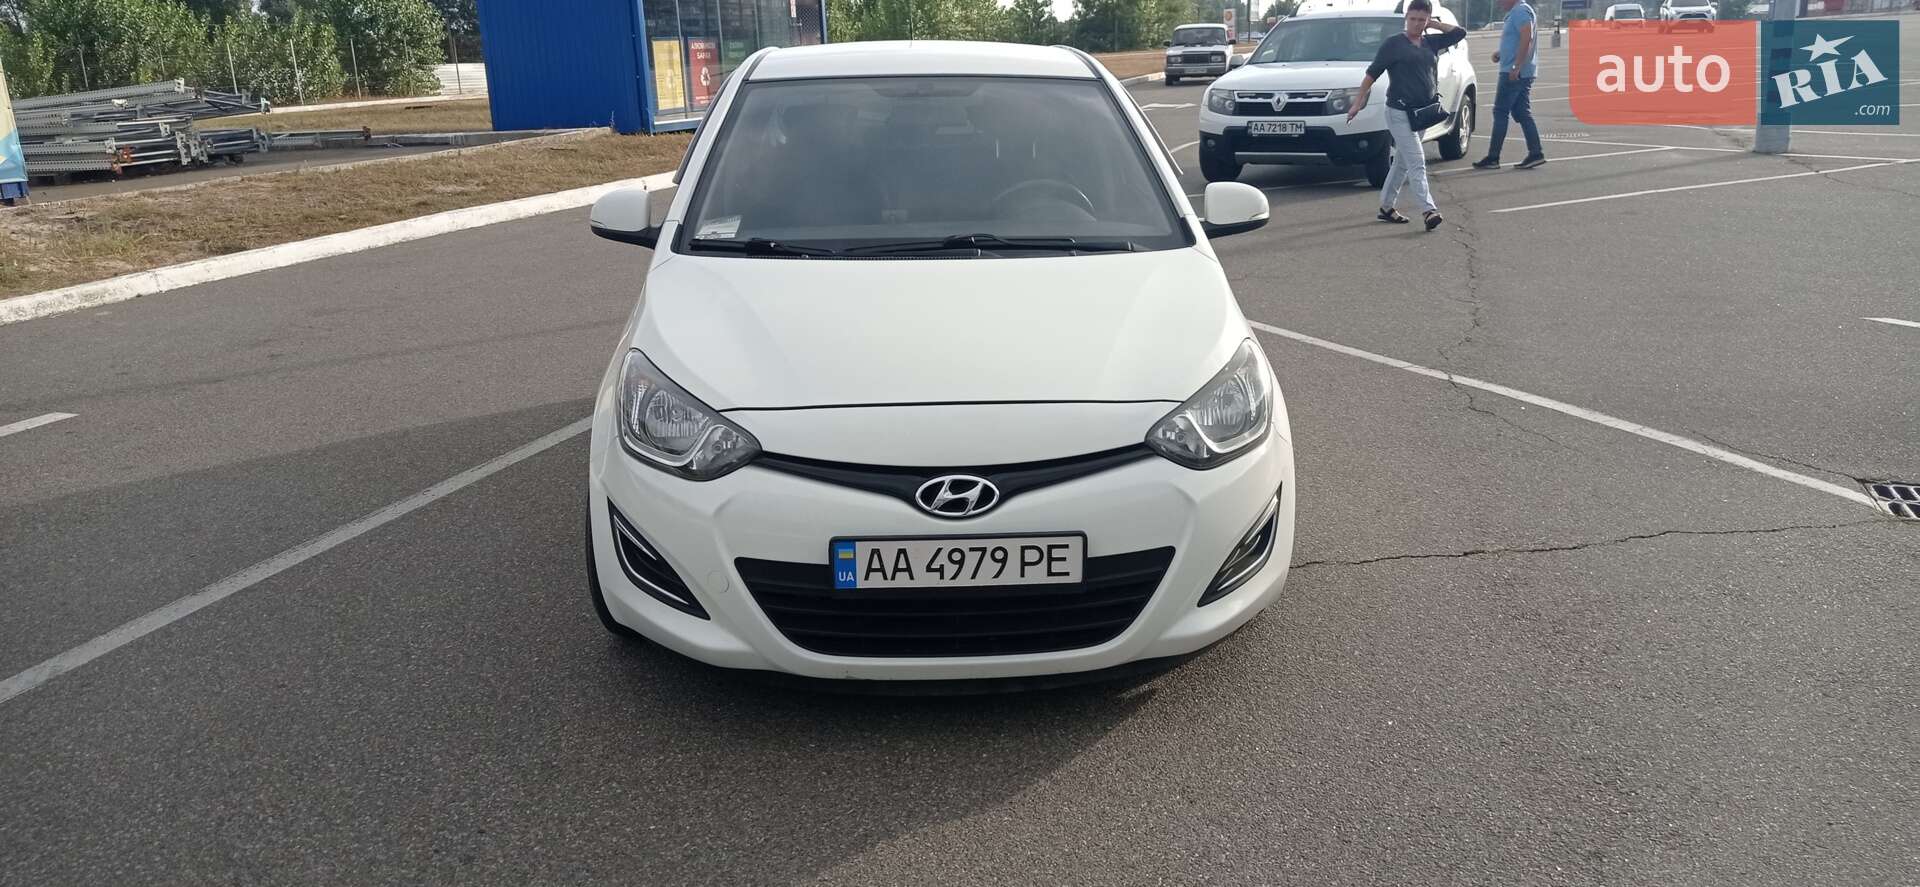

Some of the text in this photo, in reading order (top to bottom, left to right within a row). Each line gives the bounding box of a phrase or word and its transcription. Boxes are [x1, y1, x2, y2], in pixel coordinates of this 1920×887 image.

[1253, 123, 1304, 133] AA 7218 TM
[863, 544, 1070, 581] AA 4979 PE
[838, 572, 855, 582] UA
